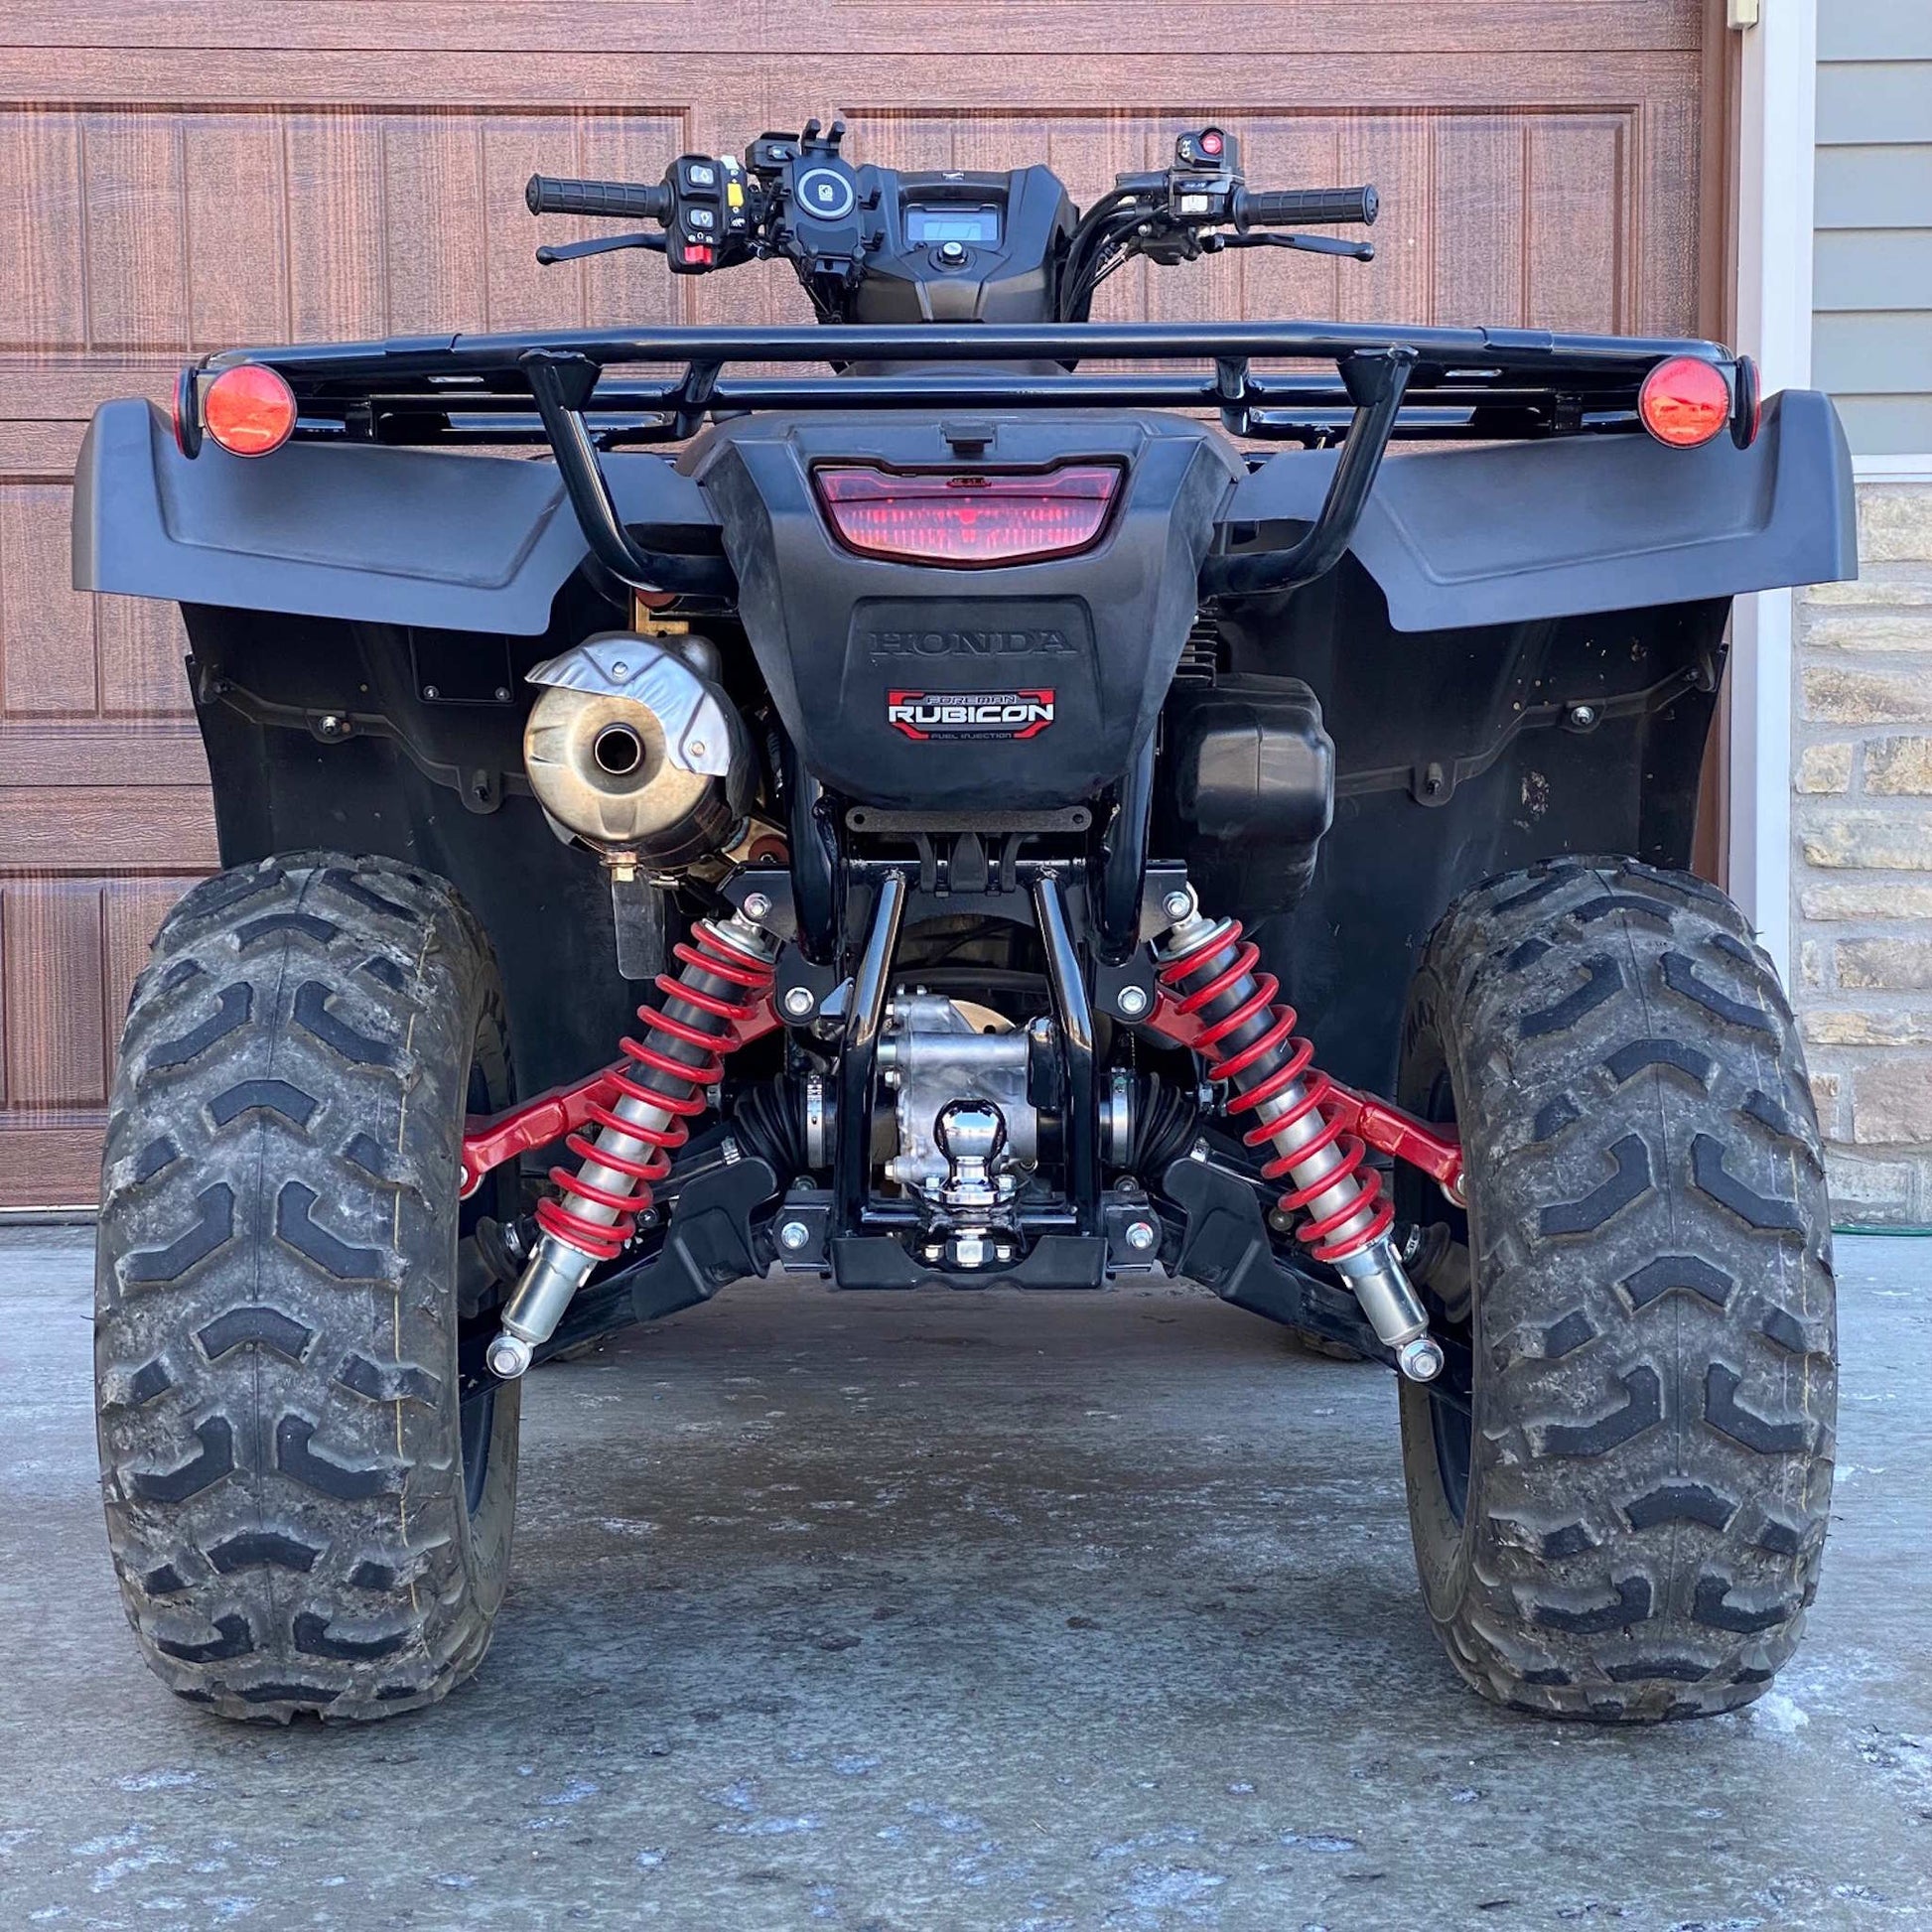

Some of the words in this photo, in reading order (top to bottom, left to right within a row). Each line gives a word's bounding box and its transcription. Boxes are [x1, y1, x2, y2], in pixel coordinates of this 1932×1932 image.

[869, 629, 1078, 655] HONDA
[927, 695, 1017, 705] FOREMAN
[889, 704, 1053, 723] RUBICON
